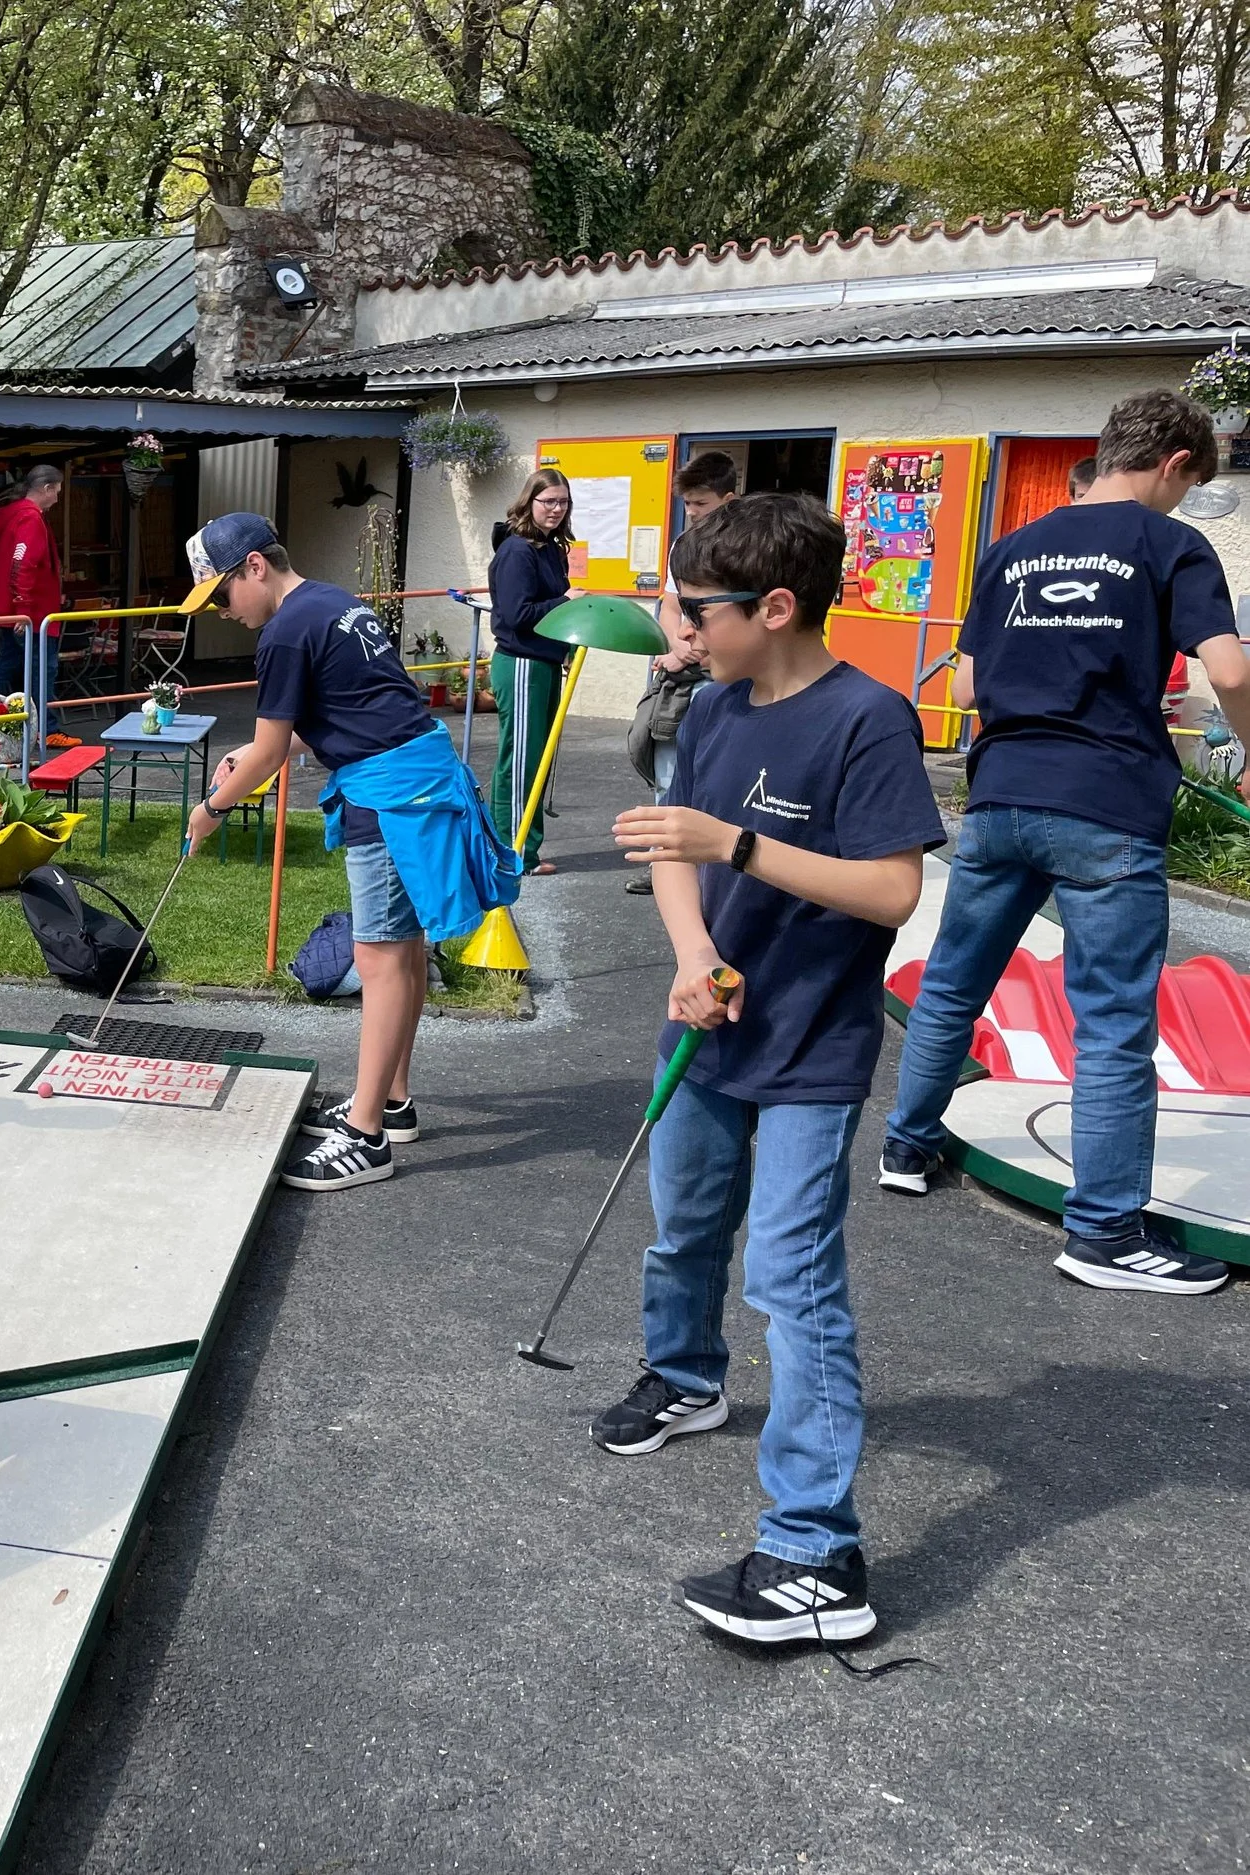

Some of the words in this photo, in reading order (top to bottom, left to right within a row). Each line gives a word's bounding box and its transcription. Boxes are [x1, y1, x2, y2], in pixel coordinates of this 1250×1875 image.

[1004, 553, 1135, 585] Ministranten
[1012, 614, 1123, 629] Aschach-Raigering
[766, 795, 811, 811] Ministranten
[43, 1064, 128, 1082] NICHT
[69, 1053, 214, 1075] BETRETEN
[140, 1073, 225, 1090] BITTE
[63, 1081, 181, 1101] BAHNEN
